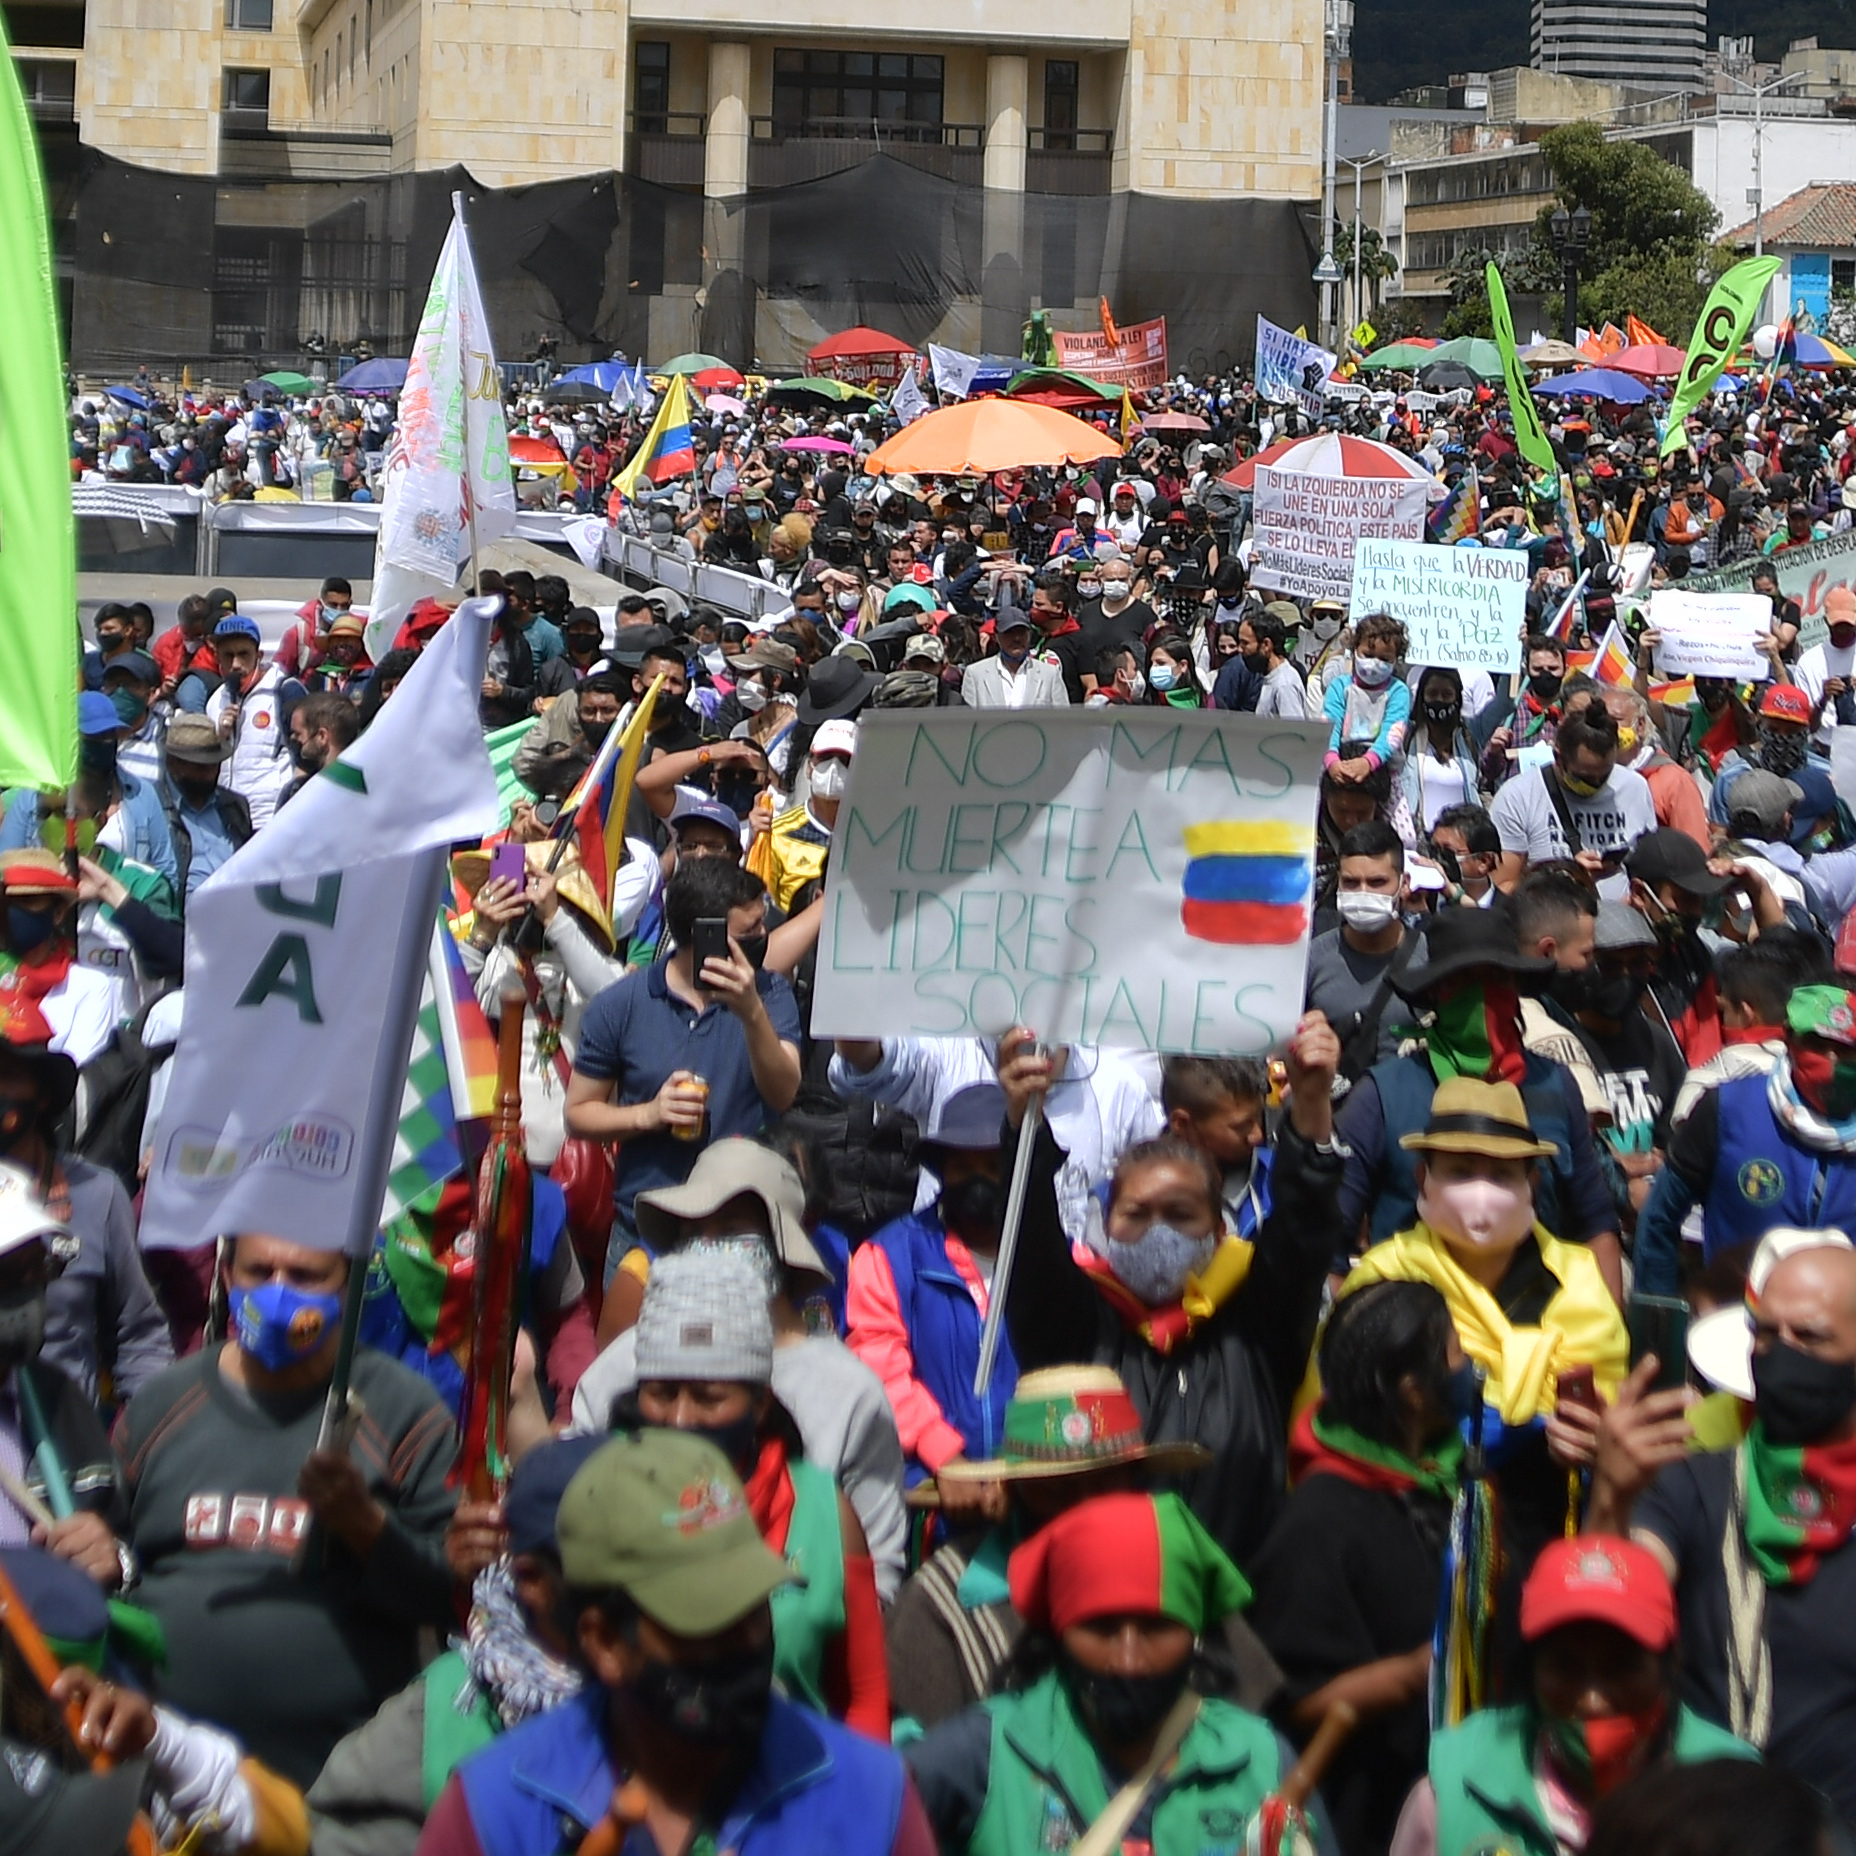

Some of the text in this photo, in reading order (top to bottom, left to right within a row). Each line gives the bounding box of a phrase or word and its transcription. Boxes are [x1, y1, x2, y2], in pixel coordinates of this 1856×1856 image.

[1064, 335, 1106, 350] VIOLAND
[1129, 329, 1142, 345] LEY
[1281, 334, 1310, 358] HAY
[1283, 474, 1299, 492] LA
[1301, 476, 1367, 500] IZQUIERDA
[1370, 482, 1387, 499] NO
[1389, 482, 1405, 500] SE
[1283, 495, 1395, 520] UNE EN UNA SOLA
[1255, 509, 1298, 531] FUERZA
[1359, 521, 1390, 539] ESTE
[1267, 531, 1284, 547] SE
[1285, 533, 1300, 552] LO
[1303, 537, 1339, 559] LLEVA
[1413, 553, 1442, 577] que
[1453, 548, 1465, 574] la
[1466, 552, 1527, 583] VERDAD
[1359, 567, 1502, 607] y la MISERICORDIA
[1470, 608, 1481, 627] y
[1488, 603, 1504, 624] la
[1420, 619, 1504, 646] y la Paz
[904, 719, 1308, 800] NO MAS
[1573, 811, 1627, 830] FITCH
[832, 889, 1098, 978] LIDERES
[86, 947, 123, 968] CGT
[910, 969, 1277, 1059] SOCIALES
